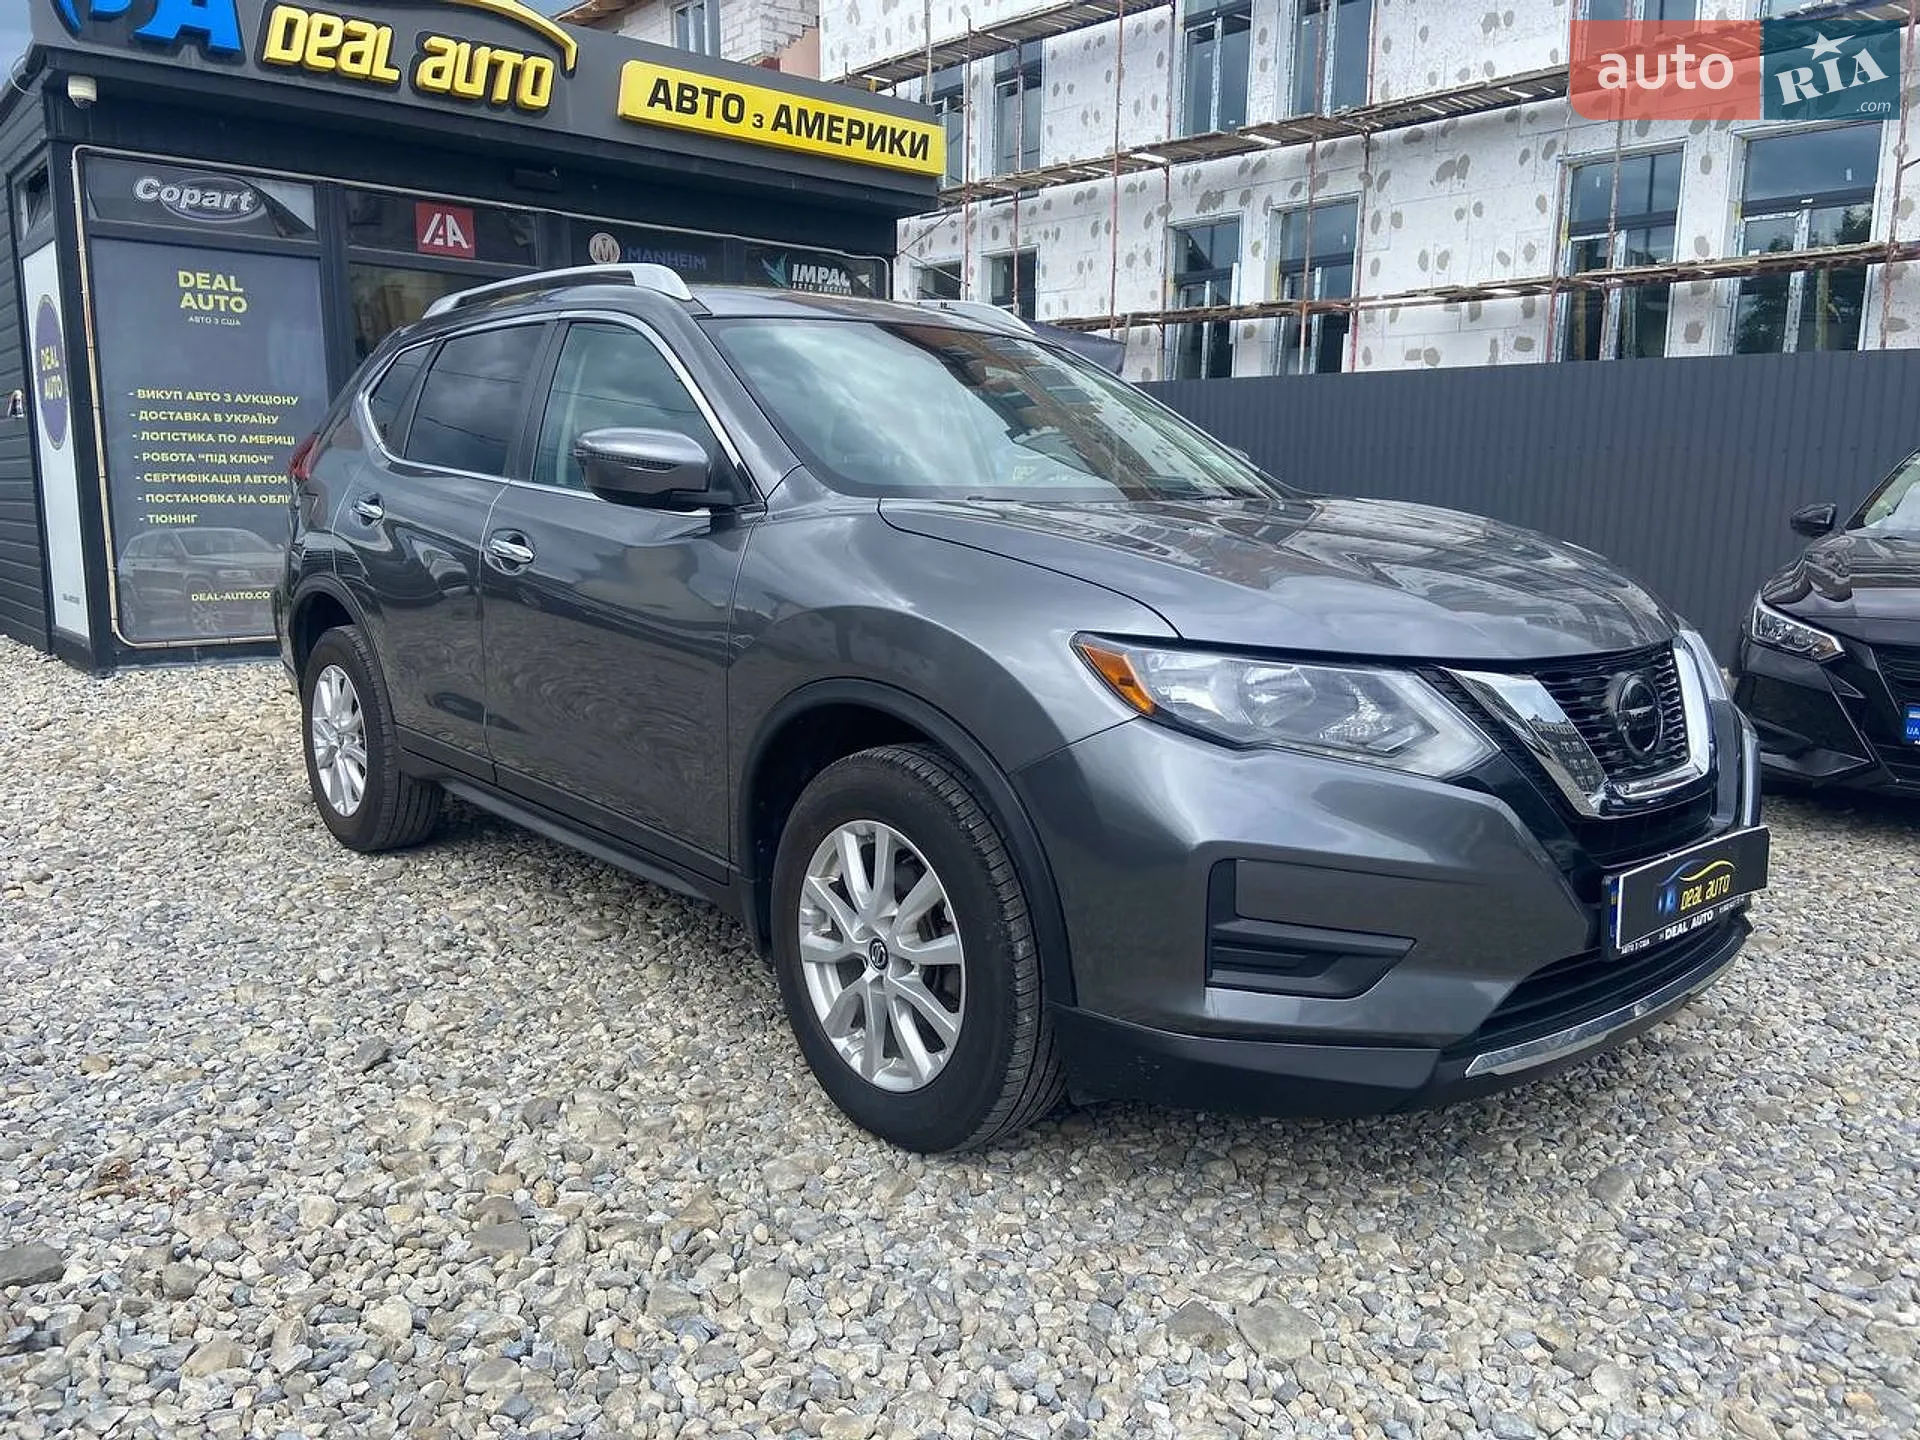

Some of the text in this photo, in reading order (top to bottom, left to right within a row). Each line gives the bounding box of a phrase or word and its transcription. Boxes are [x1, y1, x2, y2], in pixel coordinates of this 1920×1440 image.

[646, 78, 745, 124] АВТО
[771, 104, 930, 161] АМЕРИКИ
[136, 179, 252, 211] Copart
[627, 247, 707, 270] MANHEIM
[178, 271, 244, 292] DEAL
[180, 291, 248, 313] AUTO
[137, 388, 183, 400] ВИКУП
[186, 391, 221, 402] АВТО
[235, 394, 299, 406] АУКЦІОНУ
[139, 410, 213, 422] ДОСТАВКА
[225, 412, 279, 424] УКРАЇНУ
[140, 431, 216, 443] ЛОГІСТИКА
[218, 433, 237, 443] ПО
[142, 452, 195, 462] РОБОТА
[143, 473, 241, 485] СЕРТИФІКАЦІЯ
[145, 493, 236, 504] ПОСТАНОВКА
[238, 494, 257, 504] НА
[147, 514, 198, 525] ТЮНІНГ
[1665, 921, 1689, 940] DEAL
[1691, 910, 1715, 930] AUTO
